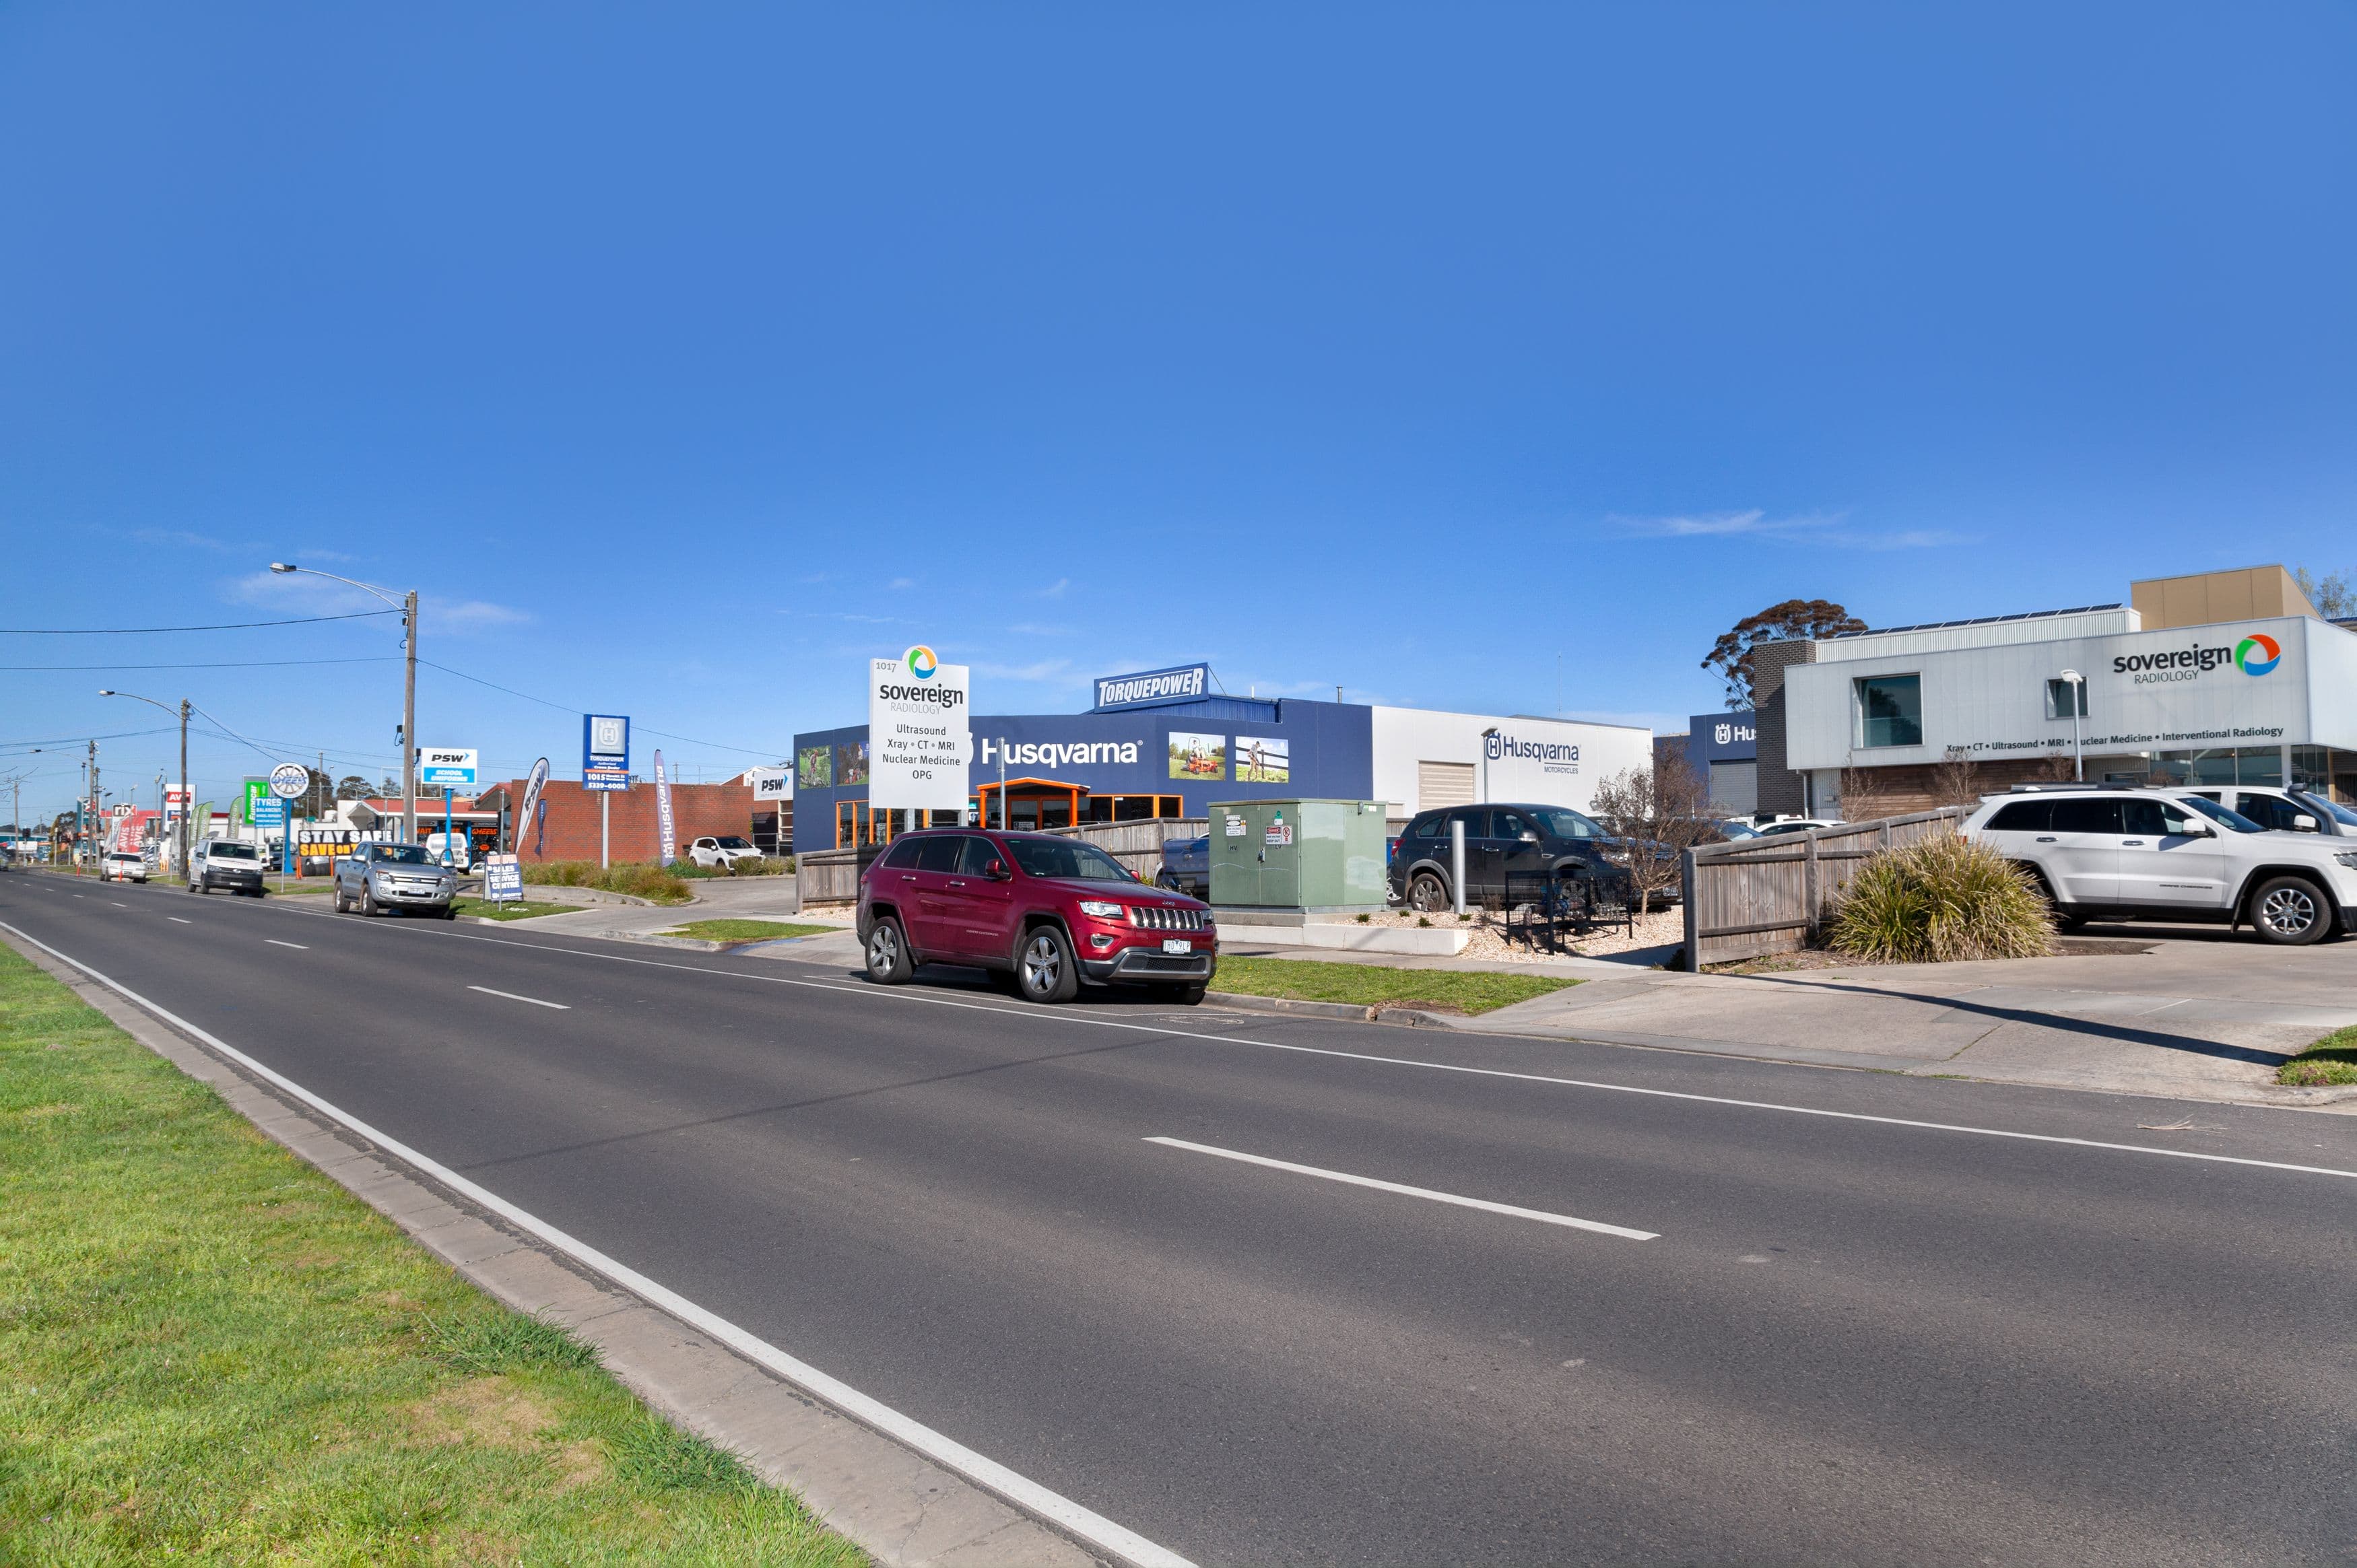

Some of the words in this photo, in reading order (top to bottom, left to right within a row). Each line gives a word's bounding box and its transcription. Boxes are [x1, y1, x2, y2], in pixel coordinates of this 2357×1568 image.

[2113, 644, 2231, 673] sovereign
[876, 662, 896, 673] 1017
[2135, 670, 2199, 684] RADIOLOGY
[1099, 667, 1203, 707] TORQUEPOWER
[879, 683, 963, 708] sovereign
[891, 702, 941, 714] RADIOLOGY
[896, 724, 946, 735] Ultrasound
[887, 739, 908, 751] Xray
[917, 740, 929, 749] CT
[938, 741, 955, 750] MRI
[1947, 744, 1965, 753] Xray
[1973, 743, 1983, 751] CT
[1992, 739, 2038, 750] Ultrasound
[2047, 739, 2065, 747] MRI
[2074, 737, 2108, 745] uclear
[2110, 734, 2153, 744] Medicine
[2162, 728, 2230, 741] Interventional
[2233, 726, 2284, 738] Radiology
[982, 738, 1137, 769] Husqvarna
[1503, 736, 1579, 762] Husqvarna
[432, 754, 463, 762] PSW
[882, 753, 917, 763] Nuclear
[920, 755, 960, 765] Medicine
[912, 770, 932, 779] OPG
[1544, 766, 1579, 774] MOTORCYCLES
[271, 776, 307, 784] WHEELS
[587, 773, 605, 781] 1015
[761, 778, 784, 791] PSW
[256, 798, 282, 807] TYRES
[657, 765, 673, 842] Husqvarna
[300, 830, 345, 843] STAY
[350, 829, 393, 842] SAFE
[300, 844, 336, 856] SAVE
